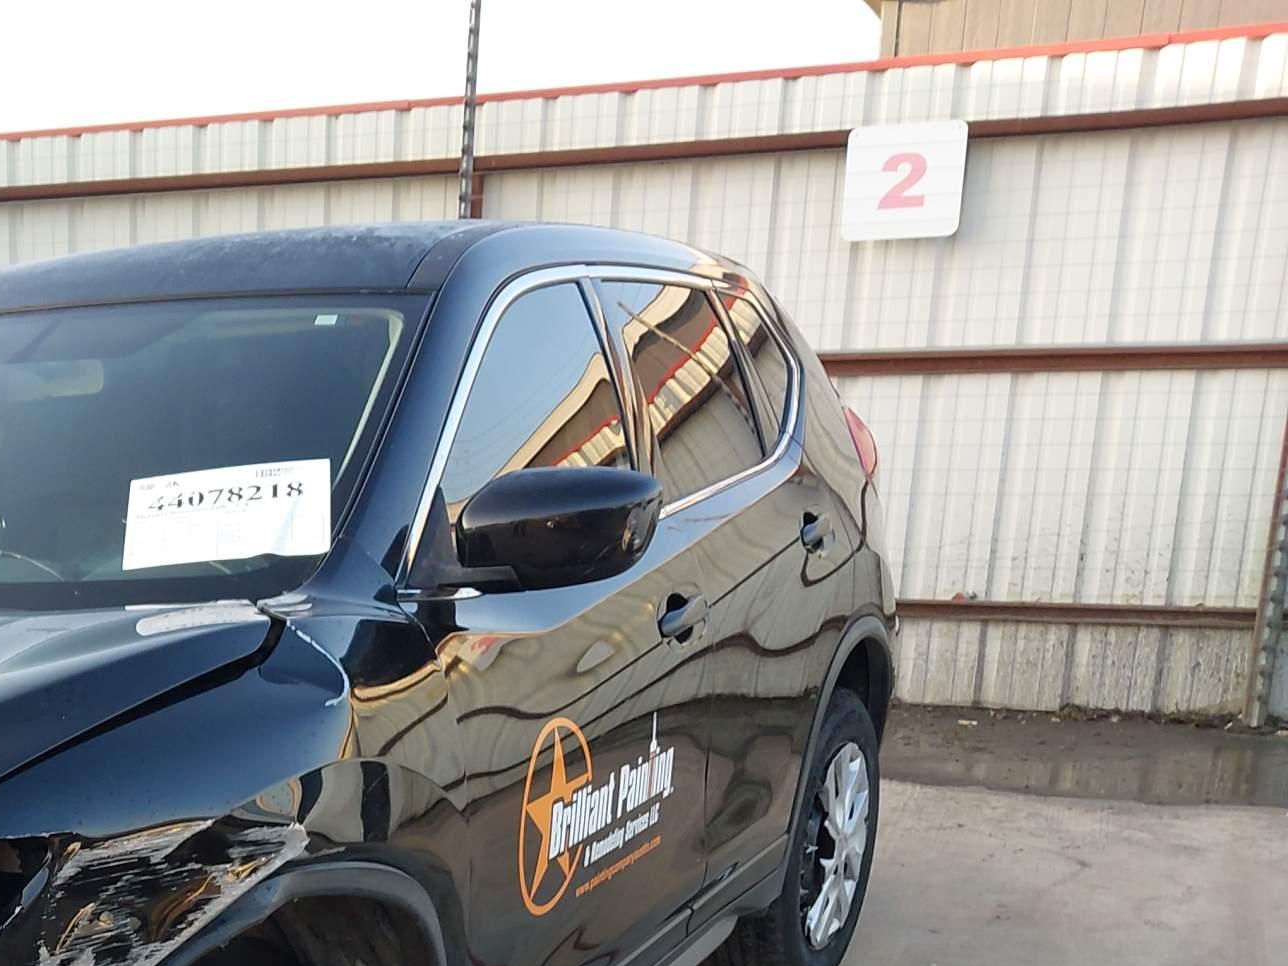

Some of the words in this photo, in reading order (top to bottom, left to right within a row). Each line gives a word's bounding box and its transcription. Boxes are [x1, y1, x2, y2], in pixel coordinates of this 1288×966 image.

[877, 152, 926, 210] 2
[149, 481, 305, 511] 44078218
[549, 772, 615, 860] Brilliant
